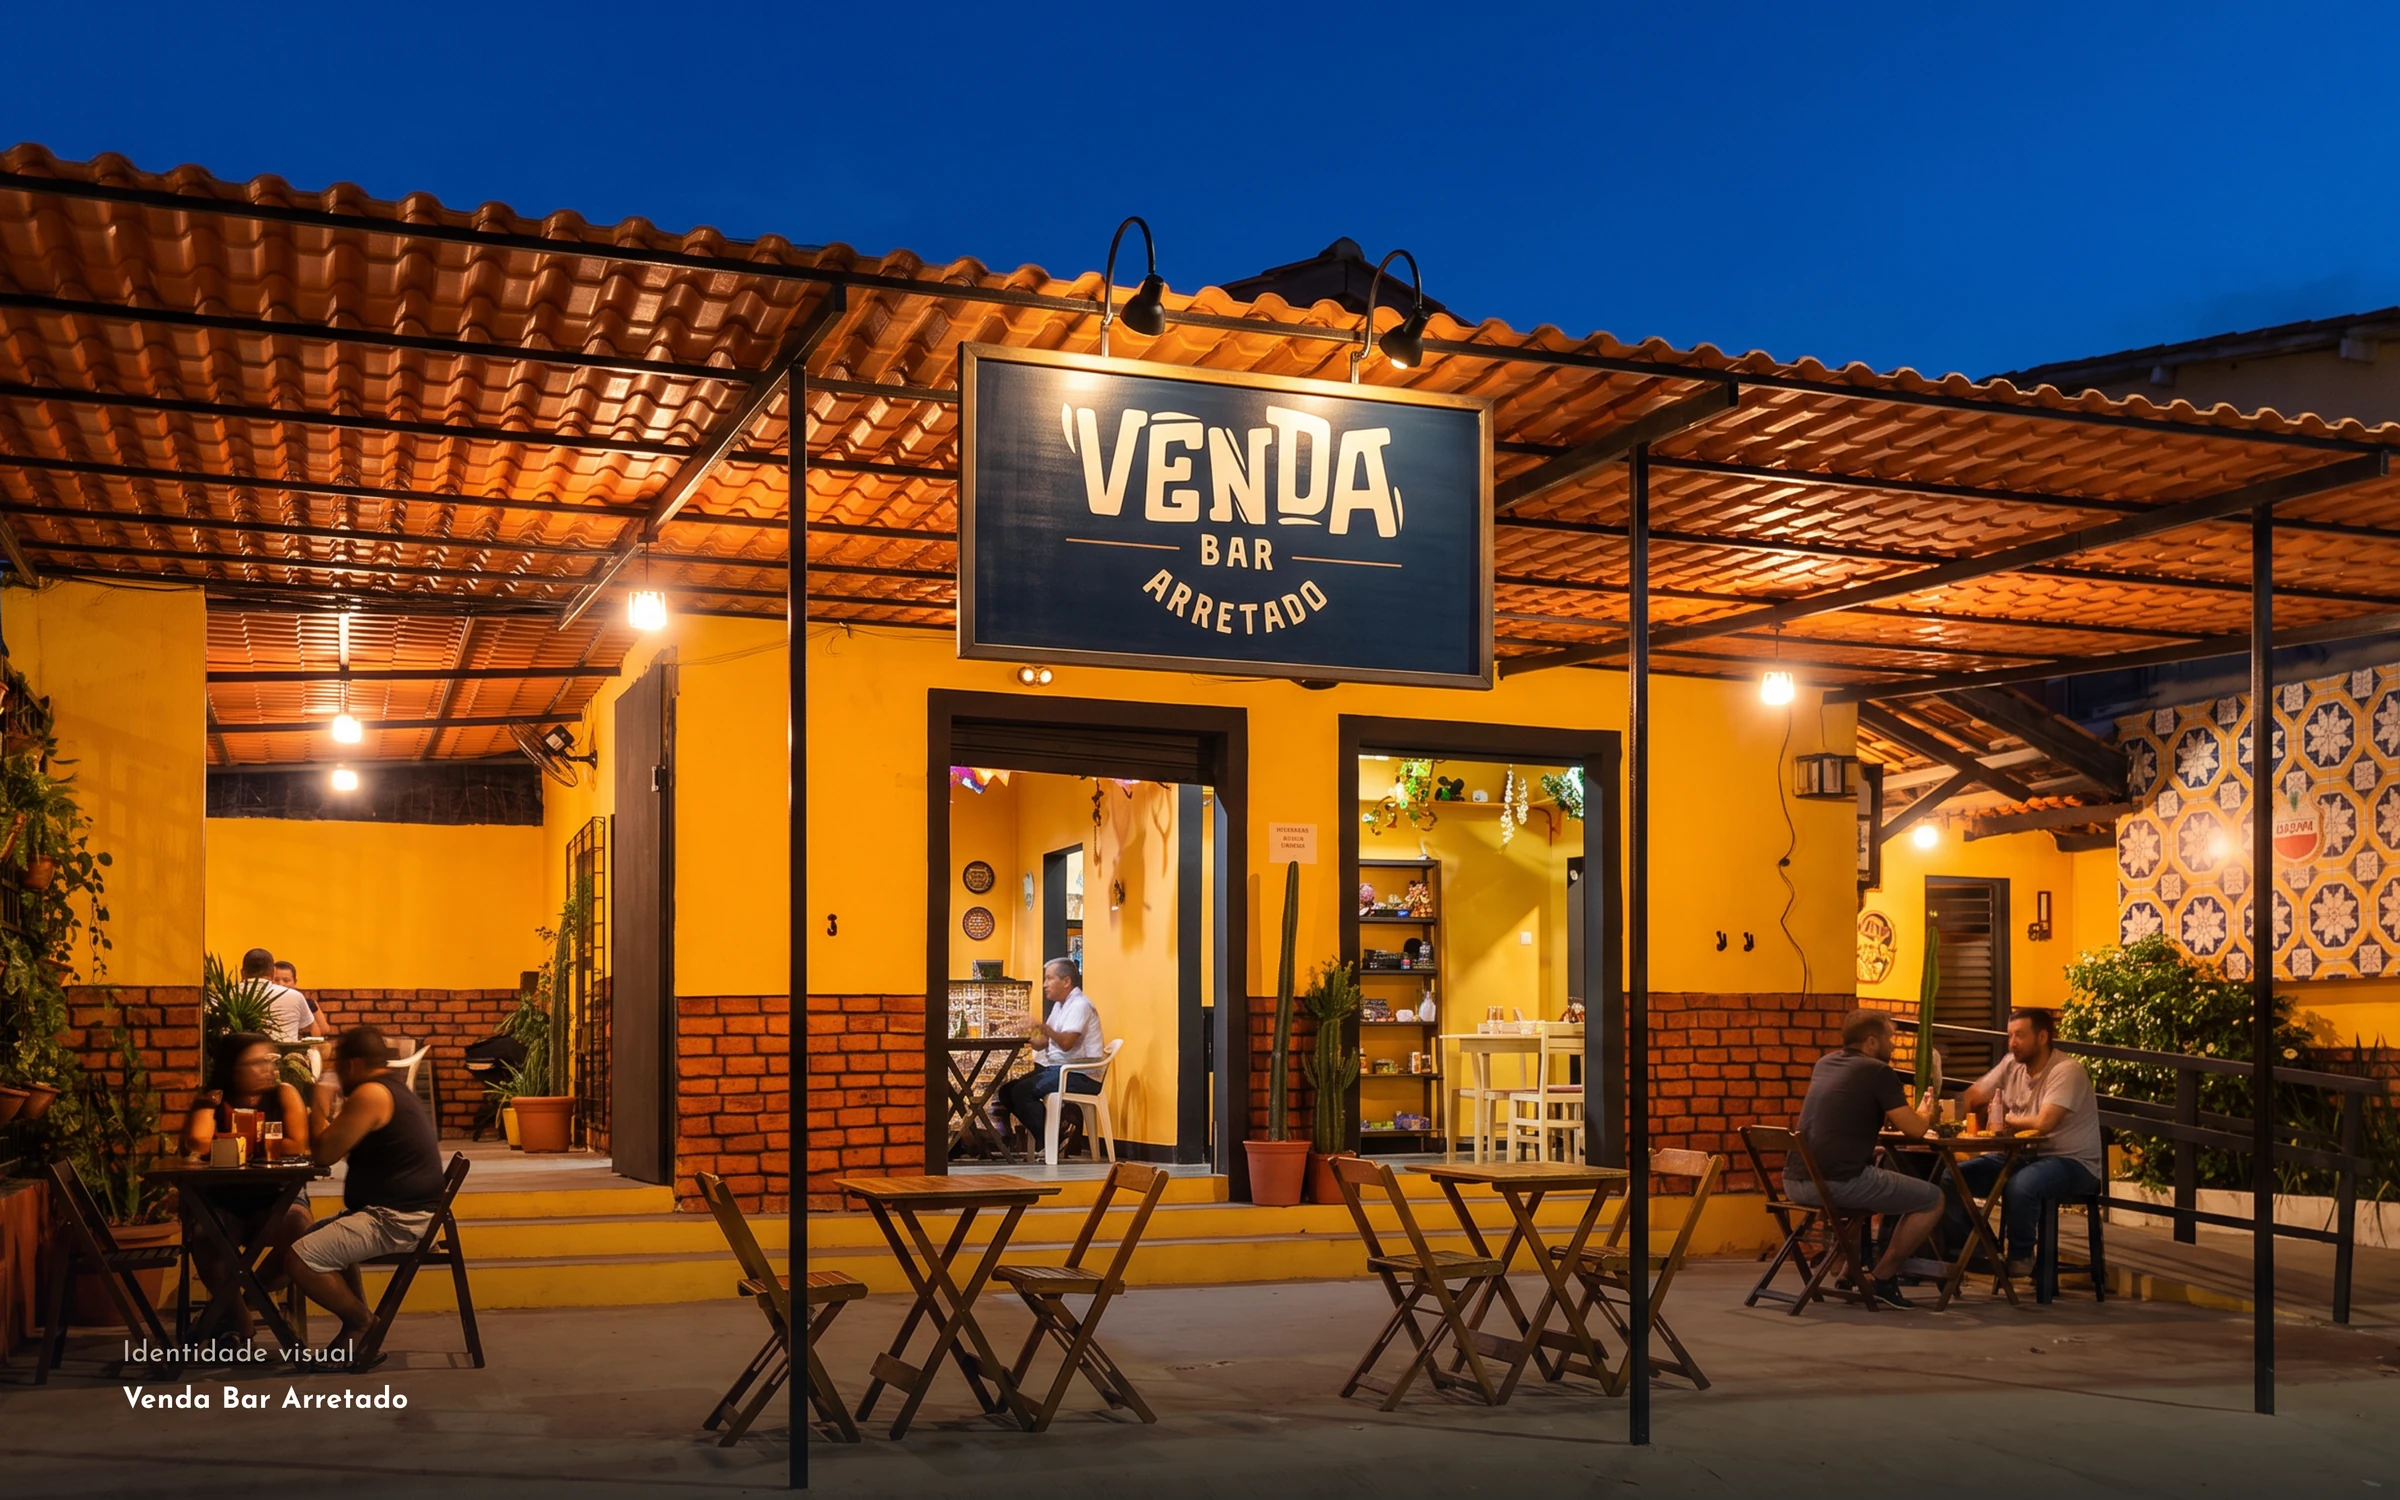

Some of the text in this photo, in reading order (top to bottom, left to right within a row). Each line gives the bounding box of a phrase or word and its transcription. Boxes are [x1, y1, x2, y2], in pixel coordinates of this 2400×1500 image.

[1068, 404, 1401, 538] VENDA
[1201, 533, 1273, 571] BAR
[1142, 568, 1328, 635] ARRETADO
